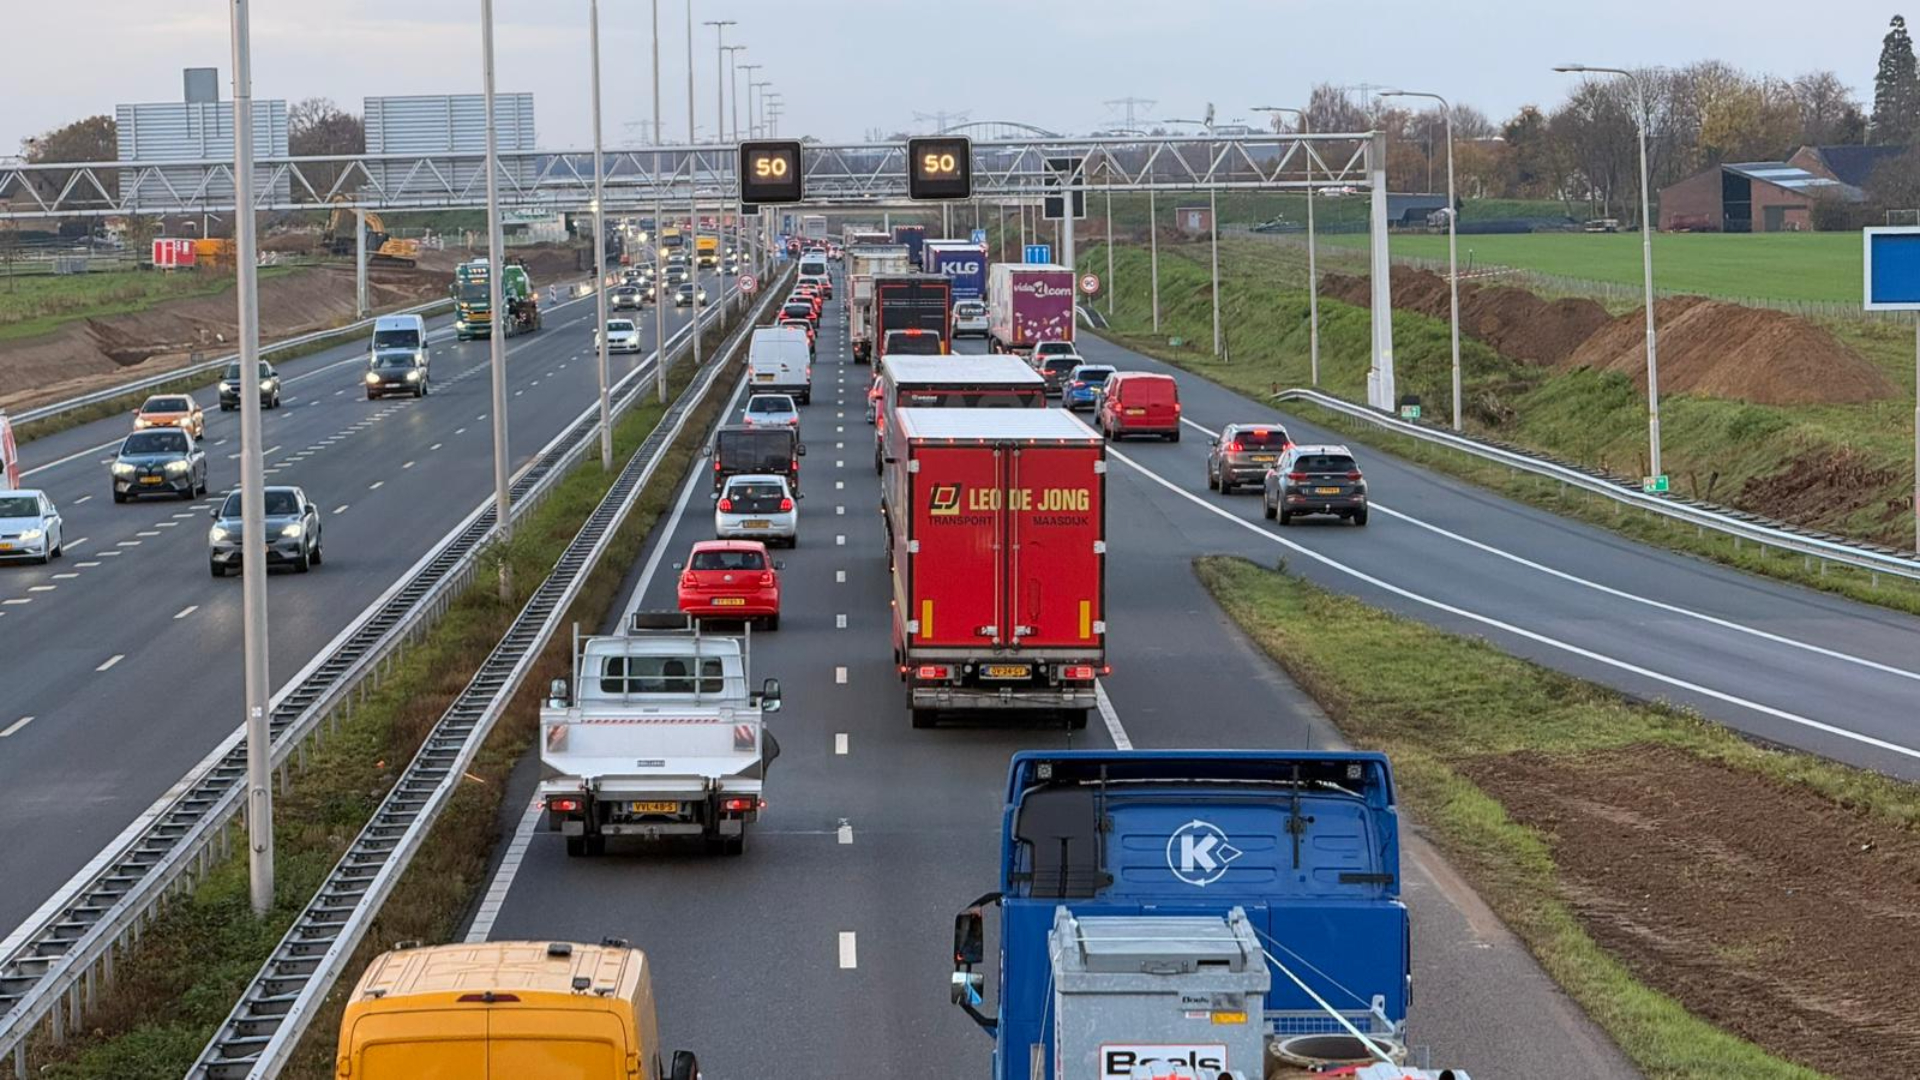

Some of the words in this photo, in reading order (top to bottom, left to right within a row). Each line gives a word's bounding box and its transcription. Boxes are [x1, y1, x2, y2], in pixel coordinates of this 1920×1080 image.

[756, 158, 787, 176] 50
[924, 154, 955, 173] 50
[941, 261, 979, 275] KLG
[969, 488, 1001, 511] LEO
[1009, 488, 1032, 511] DE
[1037, 488, 1089, 511] JONG
[928, 516, 993, 526] TRANSPORT
[1033, 515, 1088, 526] MAASDIJK
[1181, 833, 1218, 873] K
